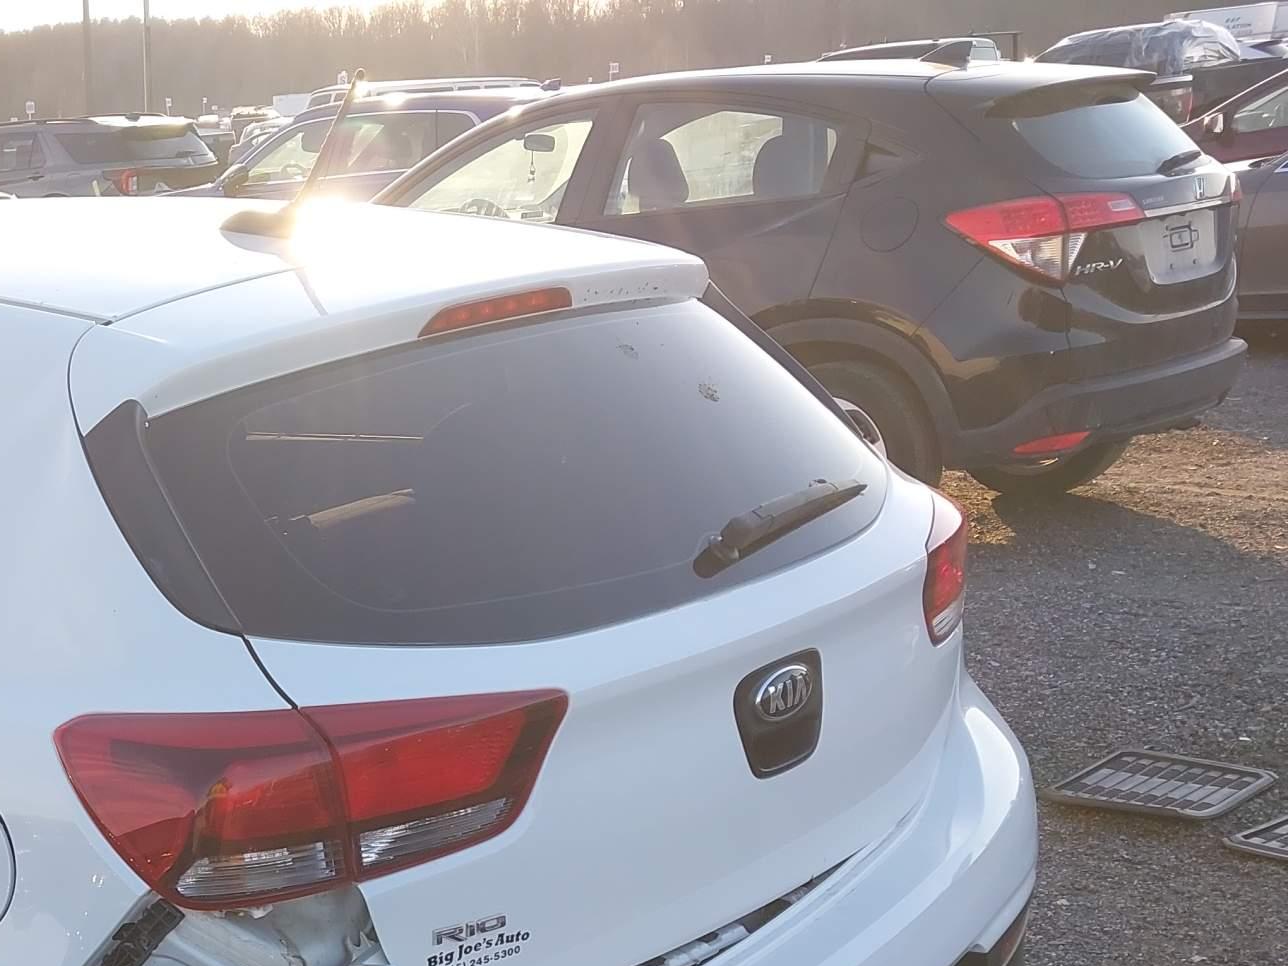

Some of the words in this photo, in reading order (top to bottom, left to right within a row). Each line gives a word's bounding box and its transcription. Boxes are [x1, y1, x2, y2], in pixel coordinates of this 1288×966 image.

[1075, 258, 1123, 276] HR-V
[768, 674, 808, 714] KIA
[432, 913, 507, 945] RIO
[458, 937, 493, 960] Joe's
[494, 930, 530, 946] Auto
